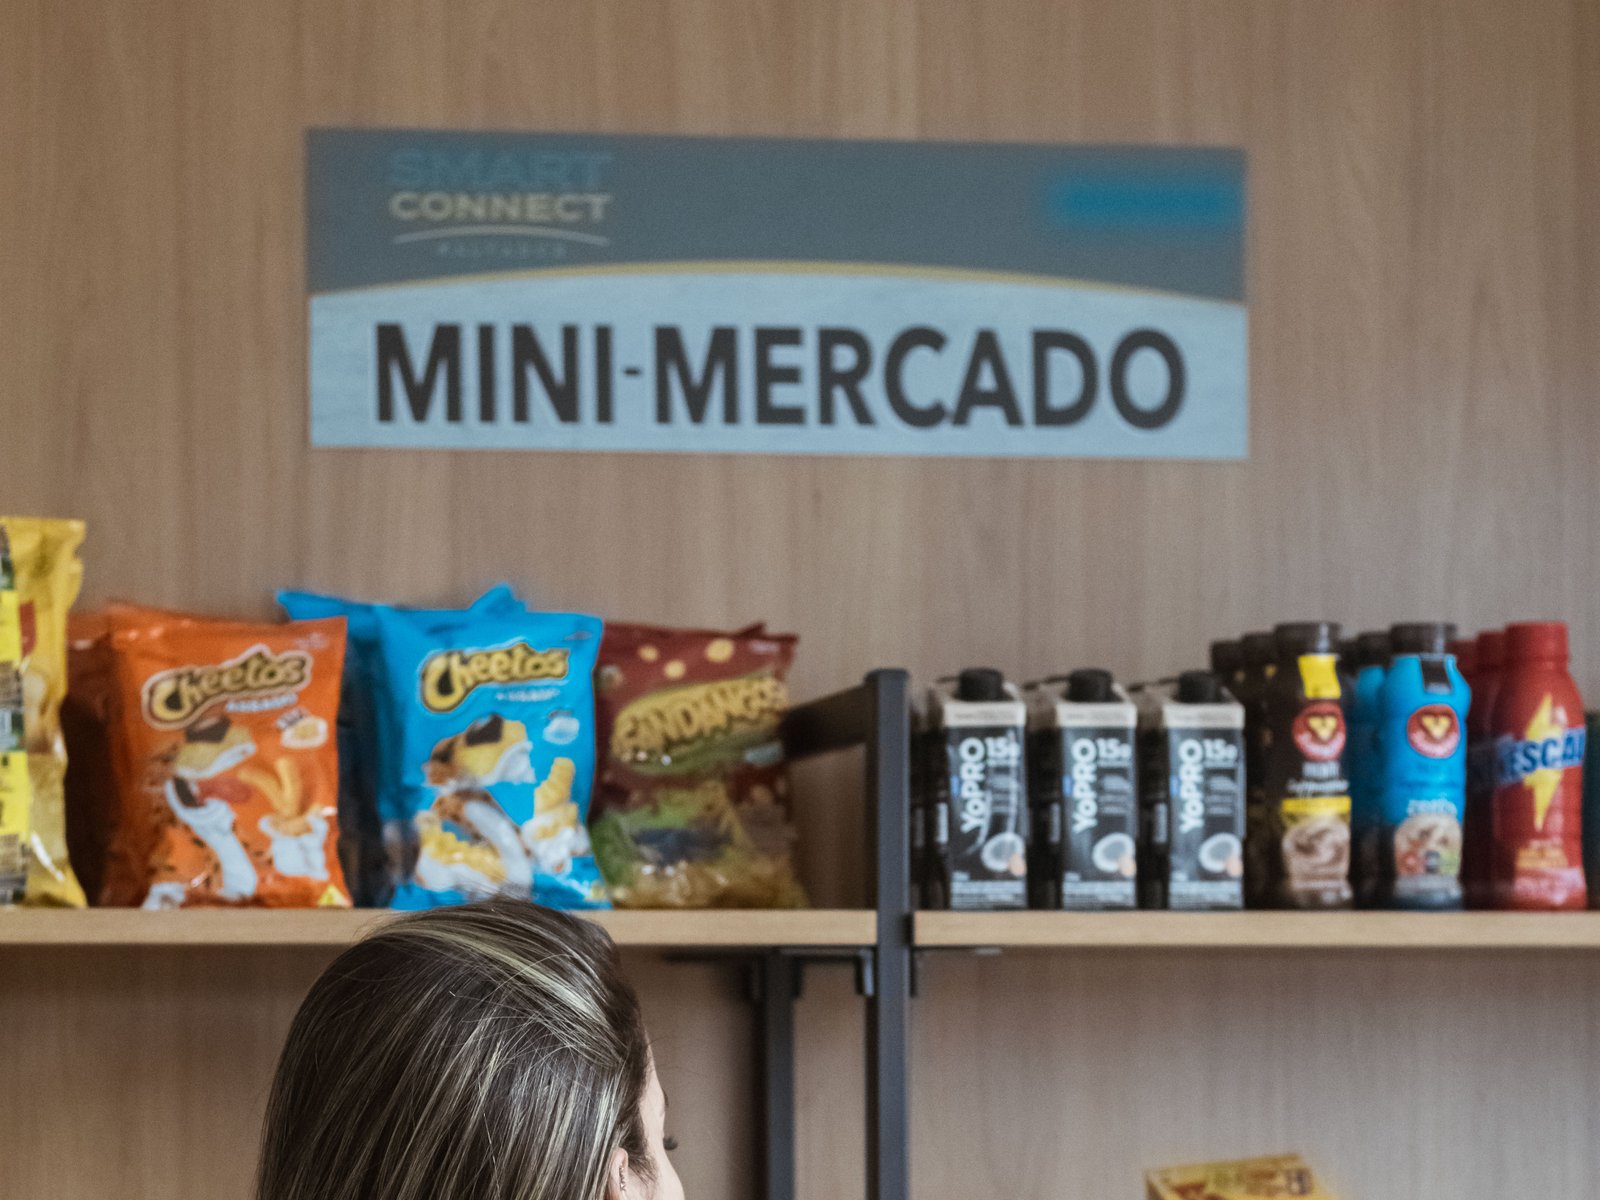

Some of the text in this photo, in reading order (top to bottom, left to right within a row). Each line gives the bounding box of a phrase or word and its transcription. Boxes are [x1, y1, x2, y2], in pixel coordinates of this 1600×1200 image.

[390, 191, 614, 223] CONNECT
[375, 321, 1188, 430] MINI-MERCADO
[148, 650, 307, 722] Cheetos
[421, 641, 569, 712] Cheetos
